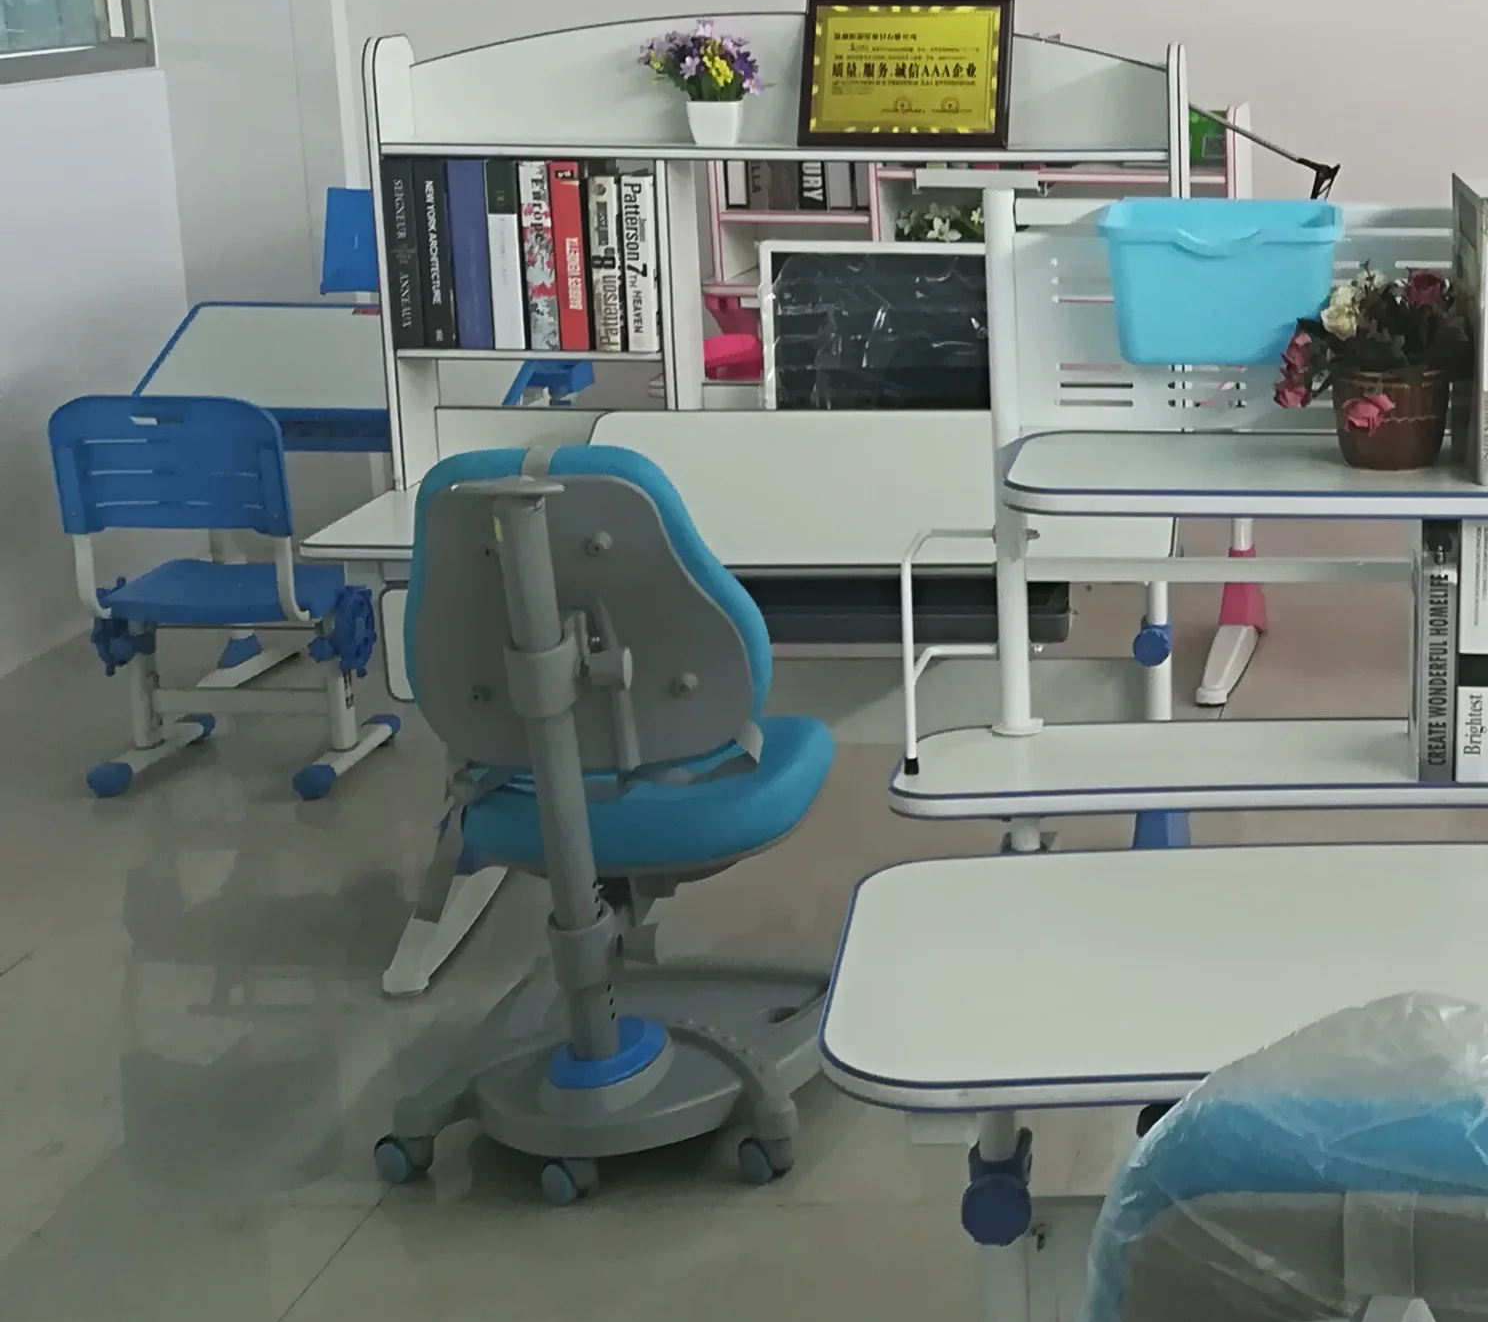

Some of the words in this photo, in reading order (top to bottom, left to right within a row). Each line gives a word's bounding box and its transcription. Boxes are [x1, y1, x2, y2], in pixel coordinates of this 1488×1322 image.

[424, 180, 435, 204] NEW
[425, 204, 437, 232] YORK
[530, 178, 548, 244] Europe
[623, 182, 642, 261] Patterson
[428, 232, 442, 305] ARCHITECTURE
[600, 274, 620, 346] Patterson
[631, 290, 643, 334] HEAVEN
[1429, 573, 1449, 636] HOMELIFE
[1428, 640, 1448, 718] WONDERFUL
[1427, 721, 1447, 766] CREATE
[1463, 693, 1487, 756] Brightest
